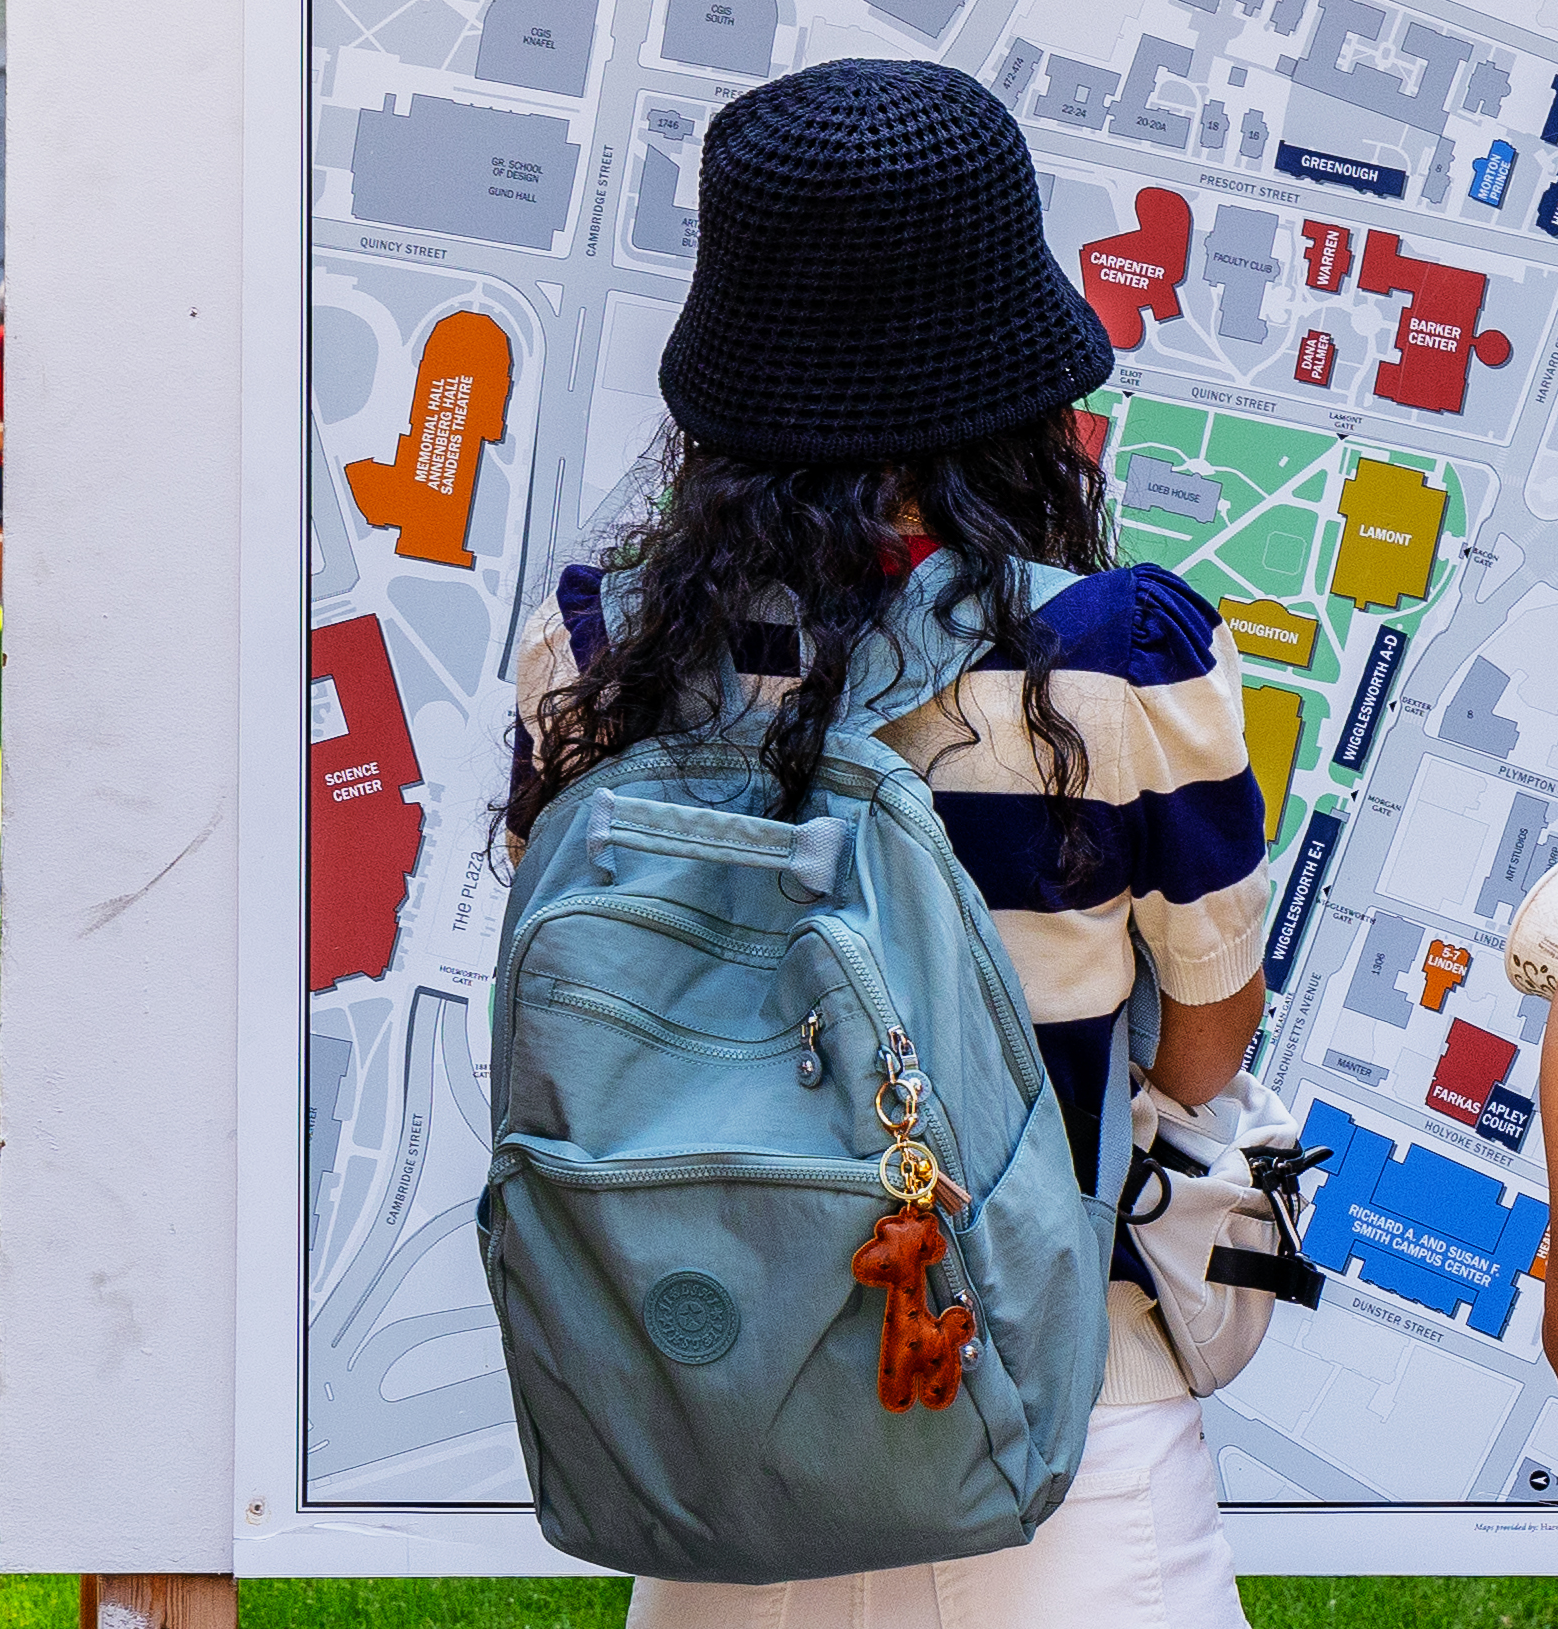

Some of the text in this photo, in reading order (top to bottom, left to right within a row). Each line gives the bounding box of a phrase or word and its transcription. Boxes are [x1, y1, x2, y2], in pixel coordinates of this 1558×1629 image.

[706, 13, 734, 26] SOUTH
[711, 4, 732, 15] CGIS
[523, 36, 556, 50] KNAFEL
[531, 27, 551, 39] CGIS
[1061, 104, 1087, 119] 22-24
[658, 119, 679, 130] 1746
[1136, 116, 1167, 132] 20-20A
[1248, 130, 1260, 141] 16
[492, 168, 539, 183] OF DESIGN
[508, 160, 543, 175] SCHOOL
[1301, 154, 1379, 182] GREENOUGH
[1477, 154, 1501, 201] MORTON
[1199, 173, 1300, 204] PRESCOTT STREET
[1490, 160, 1511, 206] PRINCE
[488, 186, 537, 203] GUND HALL
[586, 145, 614, 257] CAMBRIDGE STREET
[360, 237, 448, 259] QUINCY STREET
[1317, 230, 1340, 285] WARREN
[1090, 252, 1165, 280] CARPENTER
[1213, 252, 1273, 274] FACULTY CLUB
[1100, 268, 1149, 289] CENTER
[1410, 318, 1461, 339] BARKER
[1408, 332, 1457, 352] CENTER
[1301, 339, 1317, 370] DANA
[1311, 334, 1331, 379] PALMER
[1120, 369, 1142, 378] ELIOT
[1120, 377, 1140, 386] GATE
[1191, 386, 1277, 413] QUINCY STREET
[1329, 412, 1363, 424] LAMONT
[1334, 420, 1355, 431] GATE
[415, 378, 445, 482] MEMORIAL HALL
[427, 376, 459, 491] ANNENBERG HALL
[441, 375, 474, 496] SANDERS THEATRE
[1148, 482, 1201, 503] LOEB HOUSE
[1358, 524, 1413, 547] LAMONT
[1473, 556, 1493, 568] GATE
[1229, 618, 1299, 645] HOUGHTON
[1343, 634, 1398, 761] WIGGLESWORTH A-D
[1402, 696, 1432, 710] DEXTER
[1404, 705, 1425, 717] GATE
[325, 762, 380, 786] SCIENCE
[1498, 765, 1556, 793] PLYMPTON
[332, 778, 382, 803] CENTER
[1368, 795, 1401, 811] MORGAN
[1372, 804, 1392, 817] GATE
[1505, 827, 1529, 882] ART STUDIOS
[1271, 861, 1319, 961] WIGGLESWORTH
[1316, 897, 1377, 925] WIGGLESWORTH
[1332, 912, 1352, 925] GATE
[1473, 931, 1506, 950] LINDE
[1371, 952, 1386, 975] 1306
[1427, 954, 1468, 976] LINDEN
[1442, 947, 1461, 961] 5-7
[439, 964, 489, 982] HOLWORTHY
[452, 975, 472, 987] GATE
[1283, 992, 1295, 1011] GATE
[1271, 971, 1322, 1094] SSACHUSETTS AVENUE
[1337, 1058, 1372, 1077] MANTER
[1433, 1085, 1481, 1114] FARKAS
[1487, 1101, 1528, 1125] APLEY
[1482, 1113, 1524, 1139] COURT
[1424, 1120, 1514, 1167] HOLYOKE STREET
[386, 1113, 423, 1226] CAMBRIDGE STREET
[1348, 1204, 1501, 1278] RICHARD A. AND SUSAN F.
[1351, 1220, 1492, 1287] SMITH CAMPUS CENTER
[1352, 1297, 1445, 1343] DUNSTER STREET
